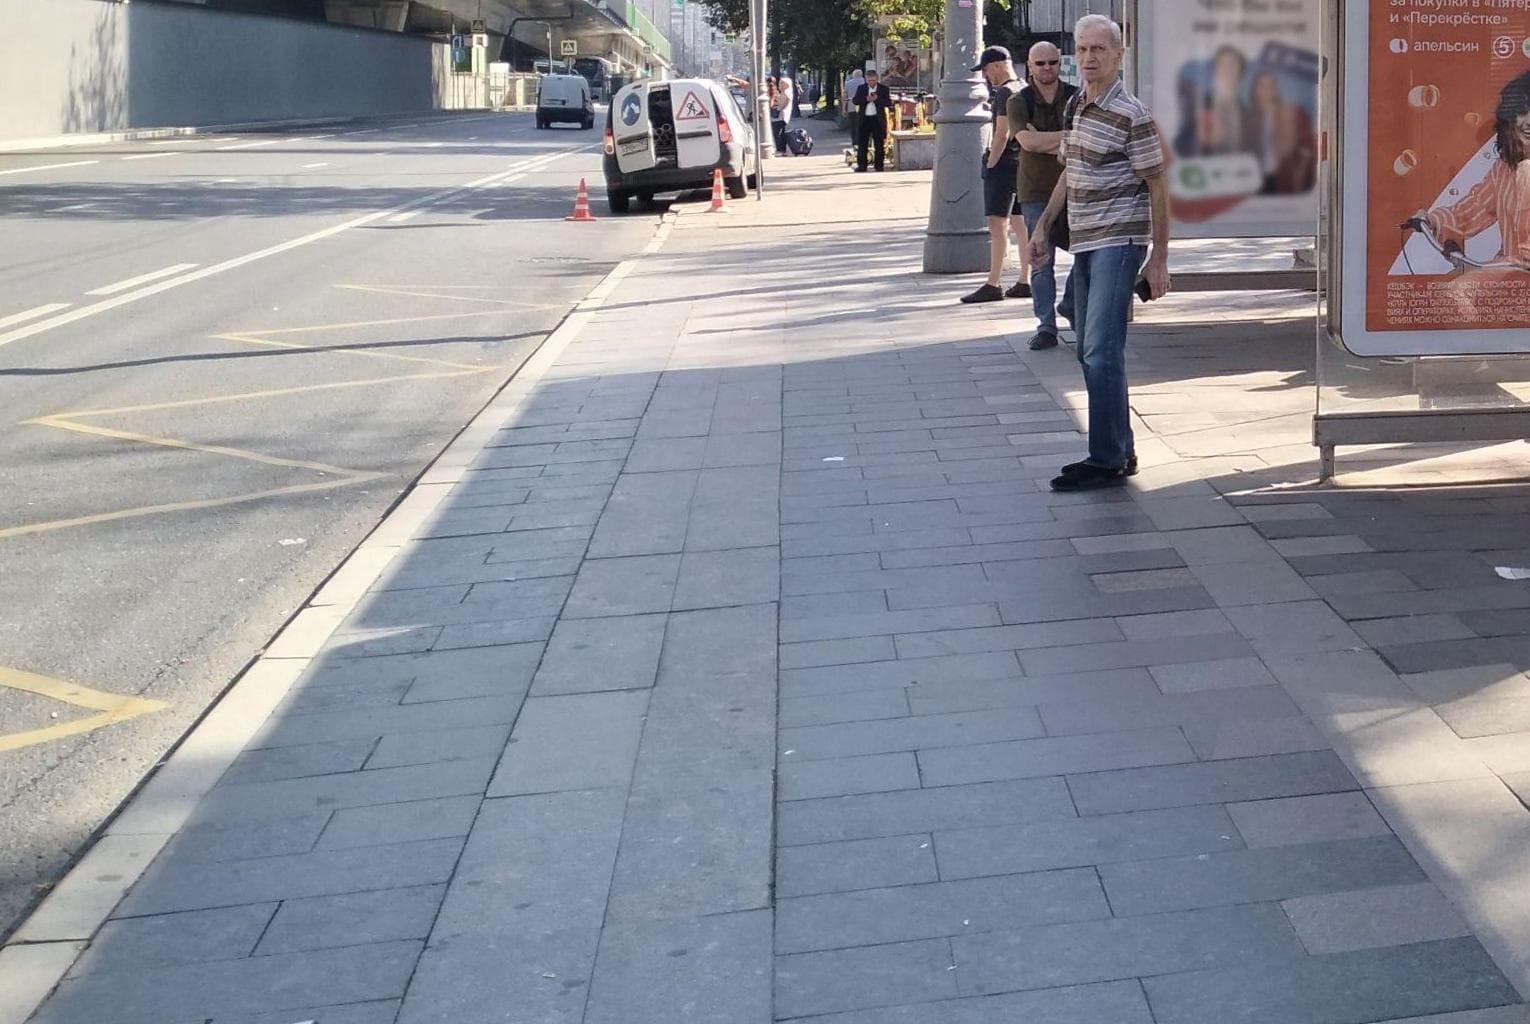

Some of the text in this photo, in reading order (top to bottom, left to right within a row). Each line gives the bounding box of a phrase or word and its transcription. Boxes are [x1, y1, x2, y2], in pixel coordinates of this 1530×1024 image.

[1390, 11, 1508, 27] и «Перекрёстке»
[1414, 41, 1479, 53] апельсин
